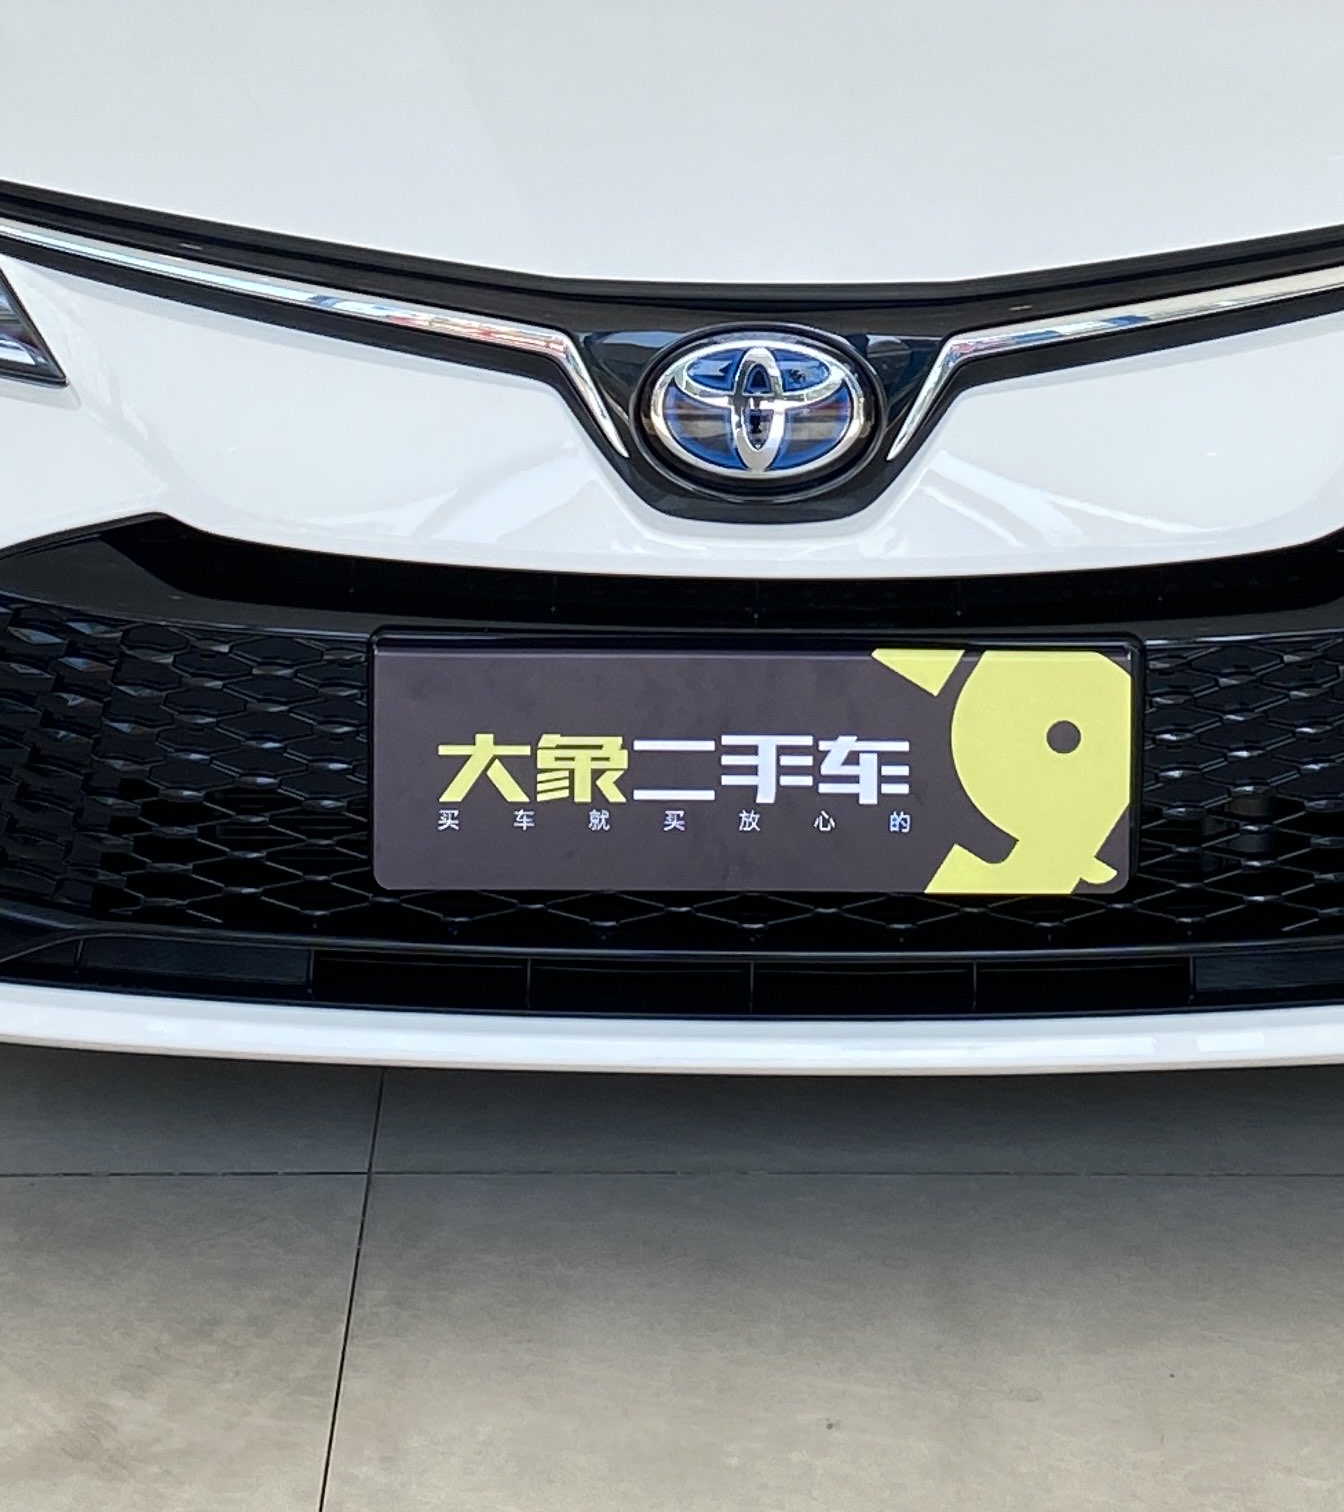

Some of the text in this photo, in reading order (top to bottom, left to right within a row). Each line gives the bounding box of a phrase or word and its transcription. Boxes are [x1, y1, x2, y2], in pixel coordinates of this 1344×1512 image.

[438, 733, 911, 805] 大象二手车
[438, 808, 911, 834] 买车就买放心的
